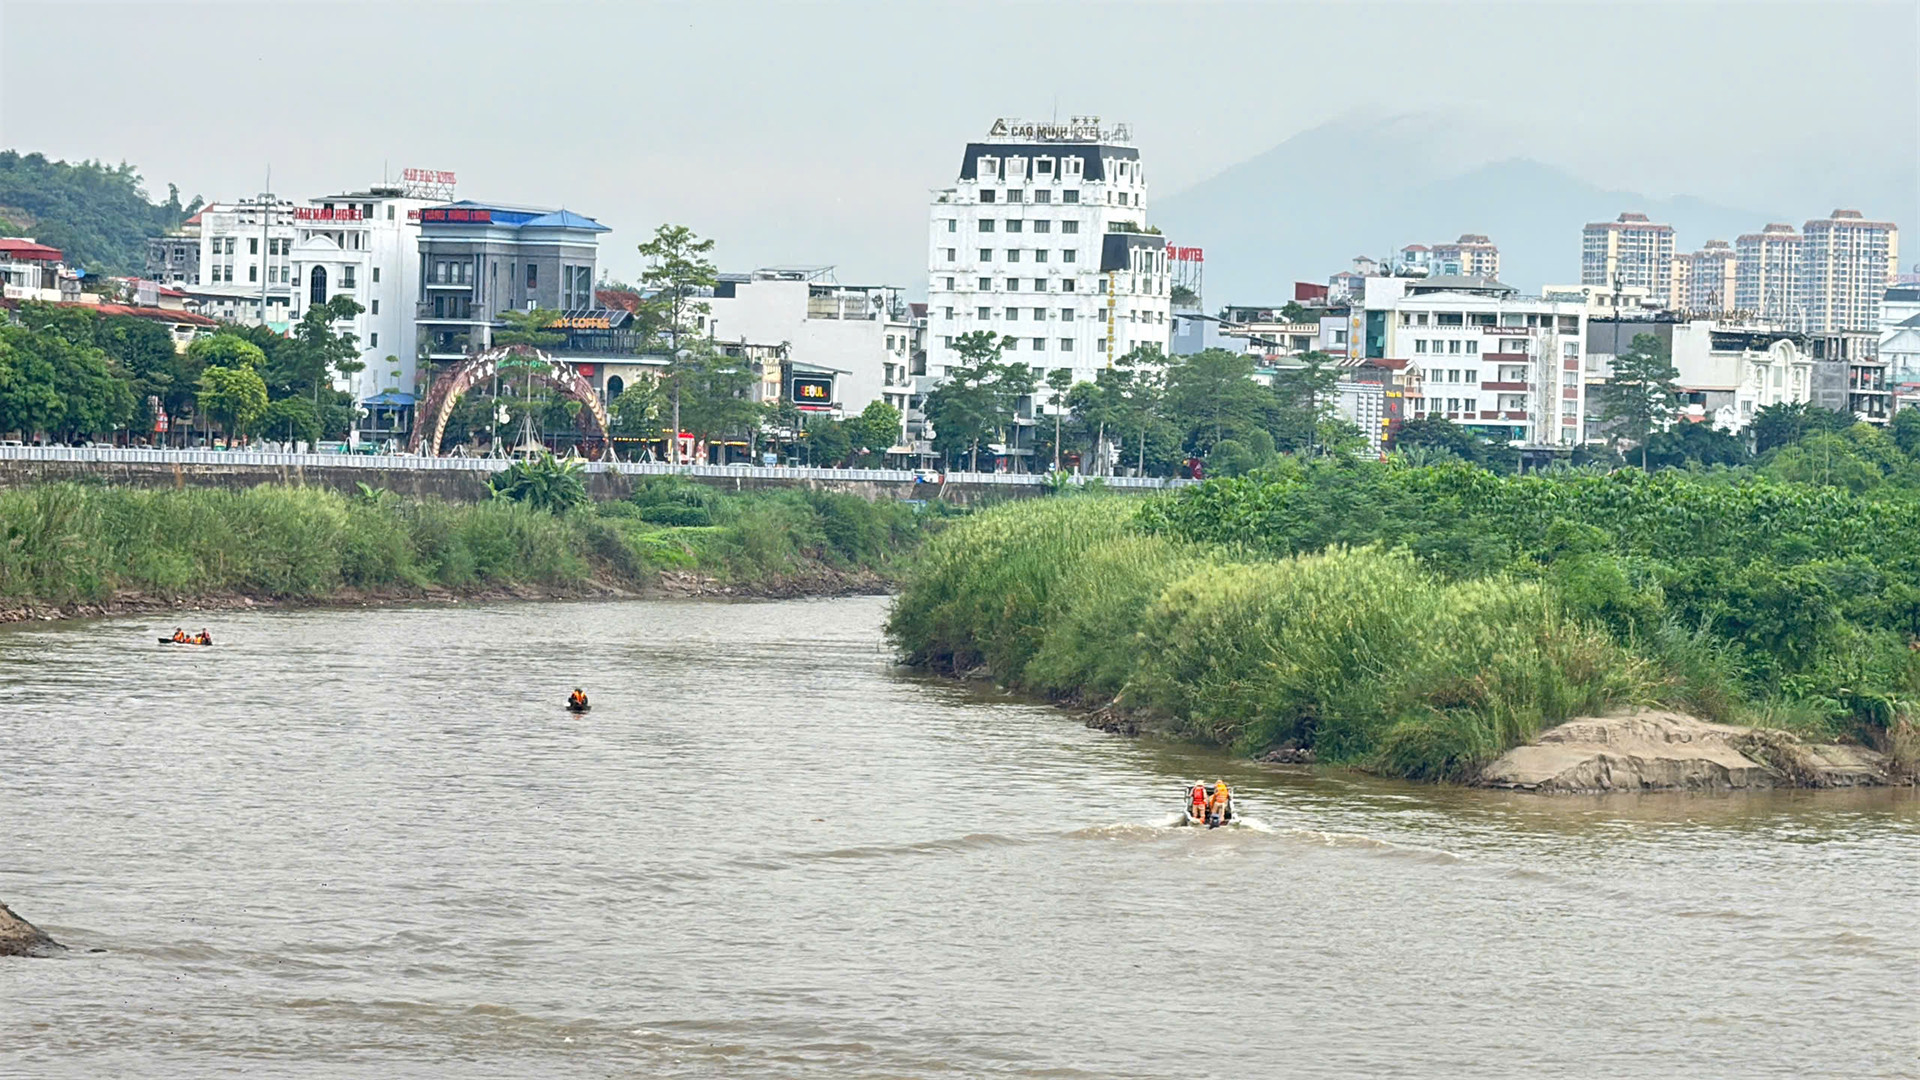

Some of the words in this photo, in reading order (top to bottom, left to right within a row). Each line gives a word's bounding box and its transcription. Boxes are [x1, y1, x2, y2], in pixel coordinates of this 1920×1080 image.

[1011, 126, 1033, 137] CAO
[1037, 126, 1068, 138] MINH
[1070, 126, 1099, 137] HOTEL
[335, 209, 363, 220] HOTEL
[1178, 247, 1203, 262] HOTEL
[572, 317, 610, 329] COFFEE
[800, 384, 823, 398] SEOUL
